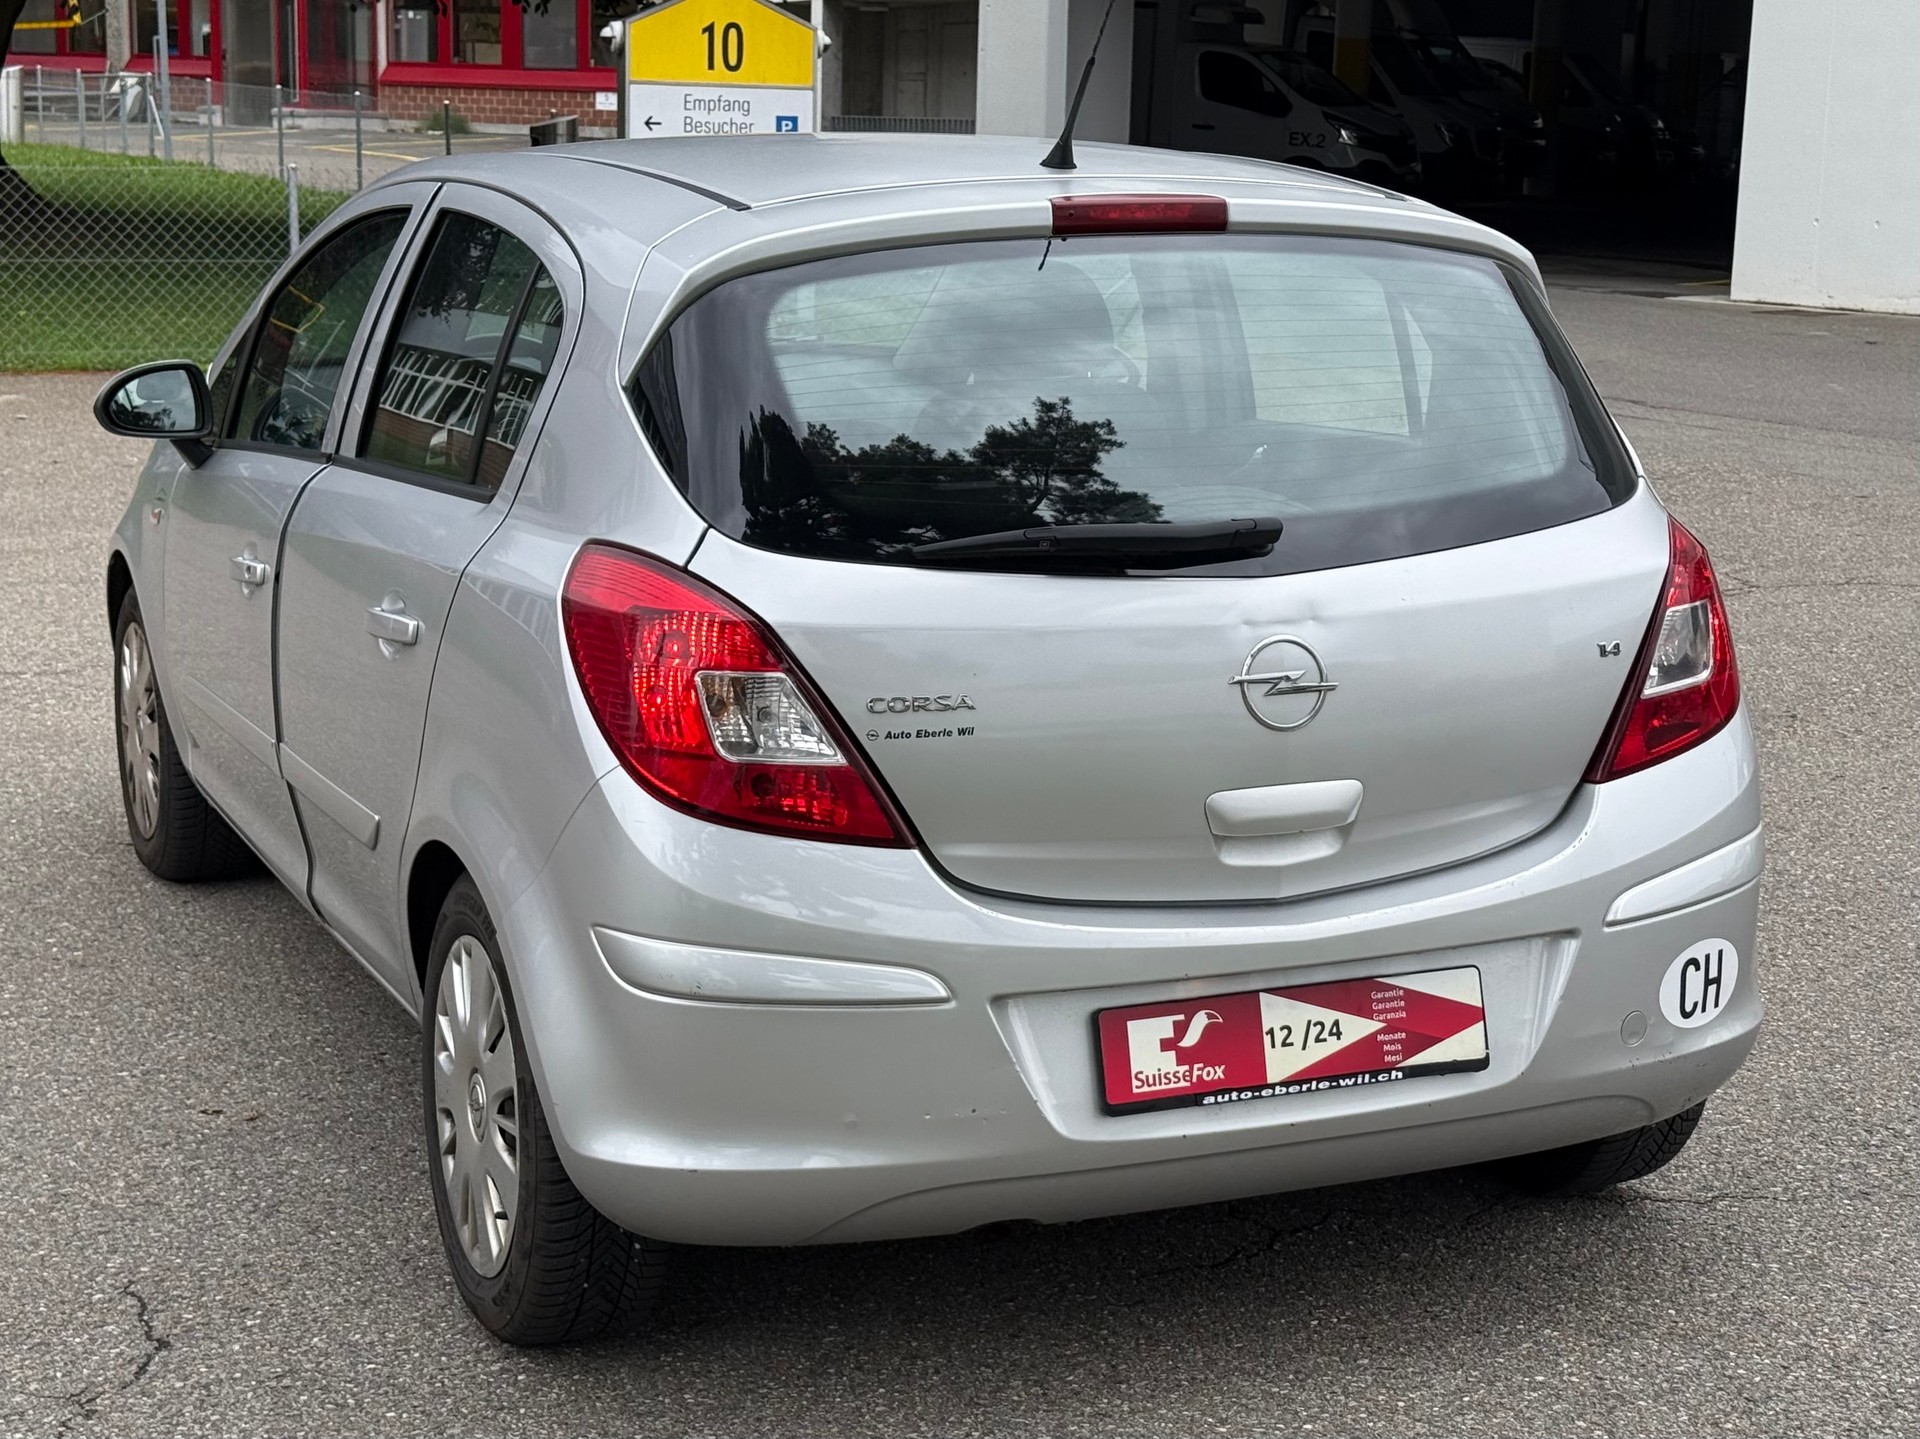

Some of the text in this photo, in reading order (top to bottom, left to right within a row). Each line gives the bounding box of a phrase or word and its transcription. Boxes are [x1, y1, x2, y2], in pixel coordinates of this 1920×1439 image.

[701, 21, 744, 72] 10
[684, 94, 750, 117] Empfang
[683, 116, 755, 135] Besucher
[1289, 131, 1326, 149] EX.2
[866, 693, 977, 714] CORSA
[884, 726, 975, 740] Auto Eberle Wil
[1680, 948, 1724, 1020] CH
[1371, 988, 1405, 999] Garantie
[1372, 999, 1405, 1010] Garantie
[1373, 1010, 1406, 1021] Garanzia
[1377, 1031, 1406, 1042] Monate
[1383, 1042, 1402, 1052] Mois
[1384, 1052, 1403, 1063] Mesi
[1134, 1063, 1226, 1090] SuisseFox
[1202, 1070, 1403, 1105] auto-eberle-wil.ch
